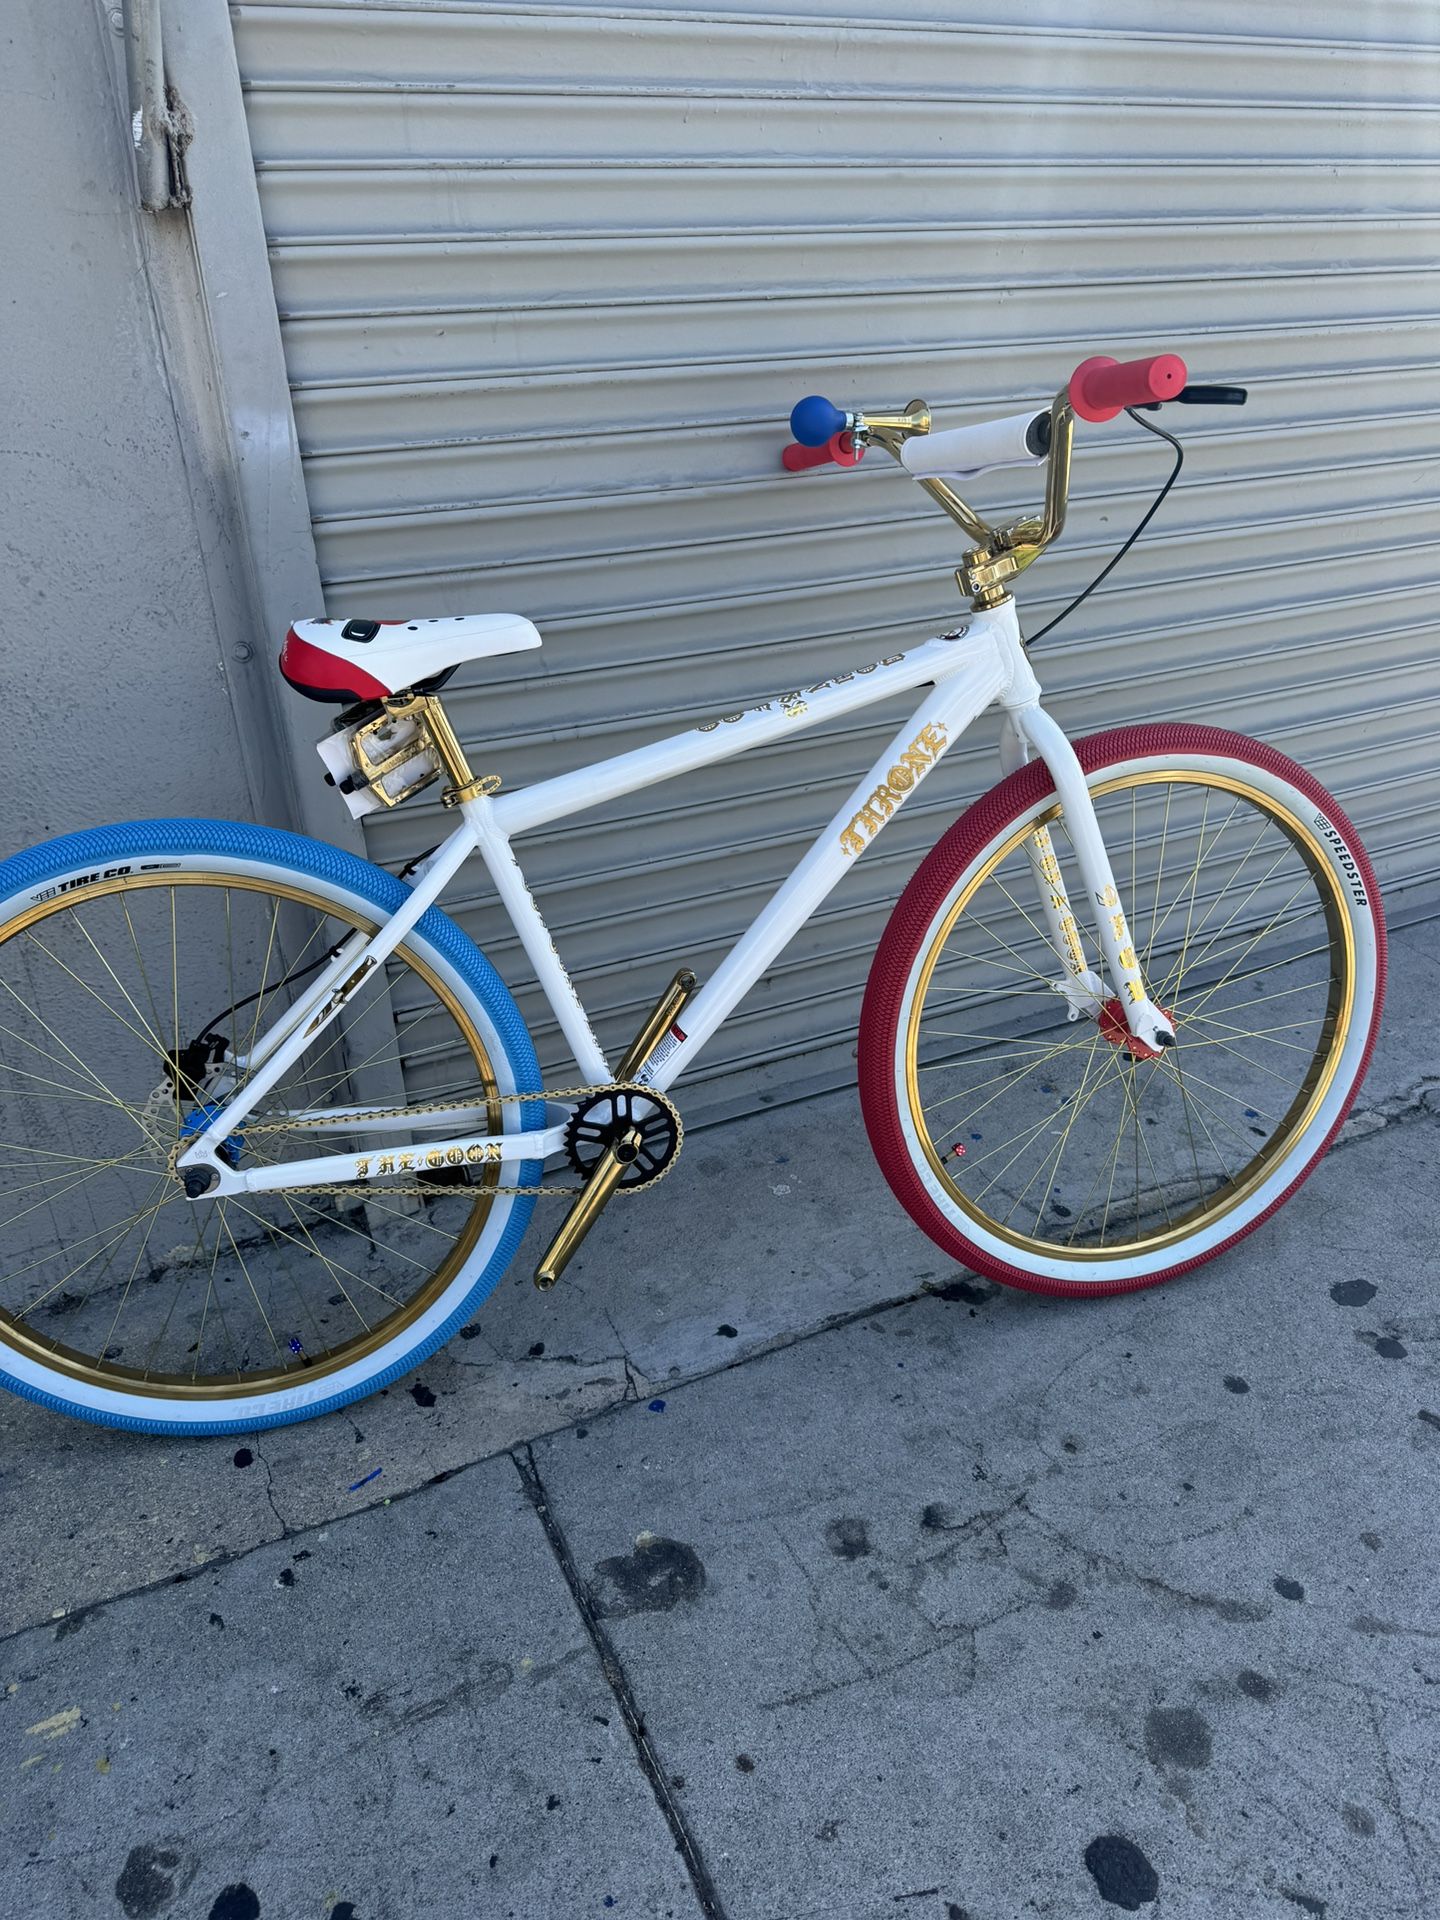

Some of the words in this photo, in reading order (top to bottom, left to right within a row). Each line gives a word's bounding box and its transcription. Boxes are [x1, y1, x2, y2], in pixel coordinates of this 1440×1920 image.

[840, 721, 947, 854] THRONE
[58, 872, 101, 892] TIRE
[103, 865, 133, 879] CO.
[1323, 829, 1368, 907] SPEEDSTER
[354, 1152, 416, 1179] THE
[424, 1141, 504, 1169] GOON
